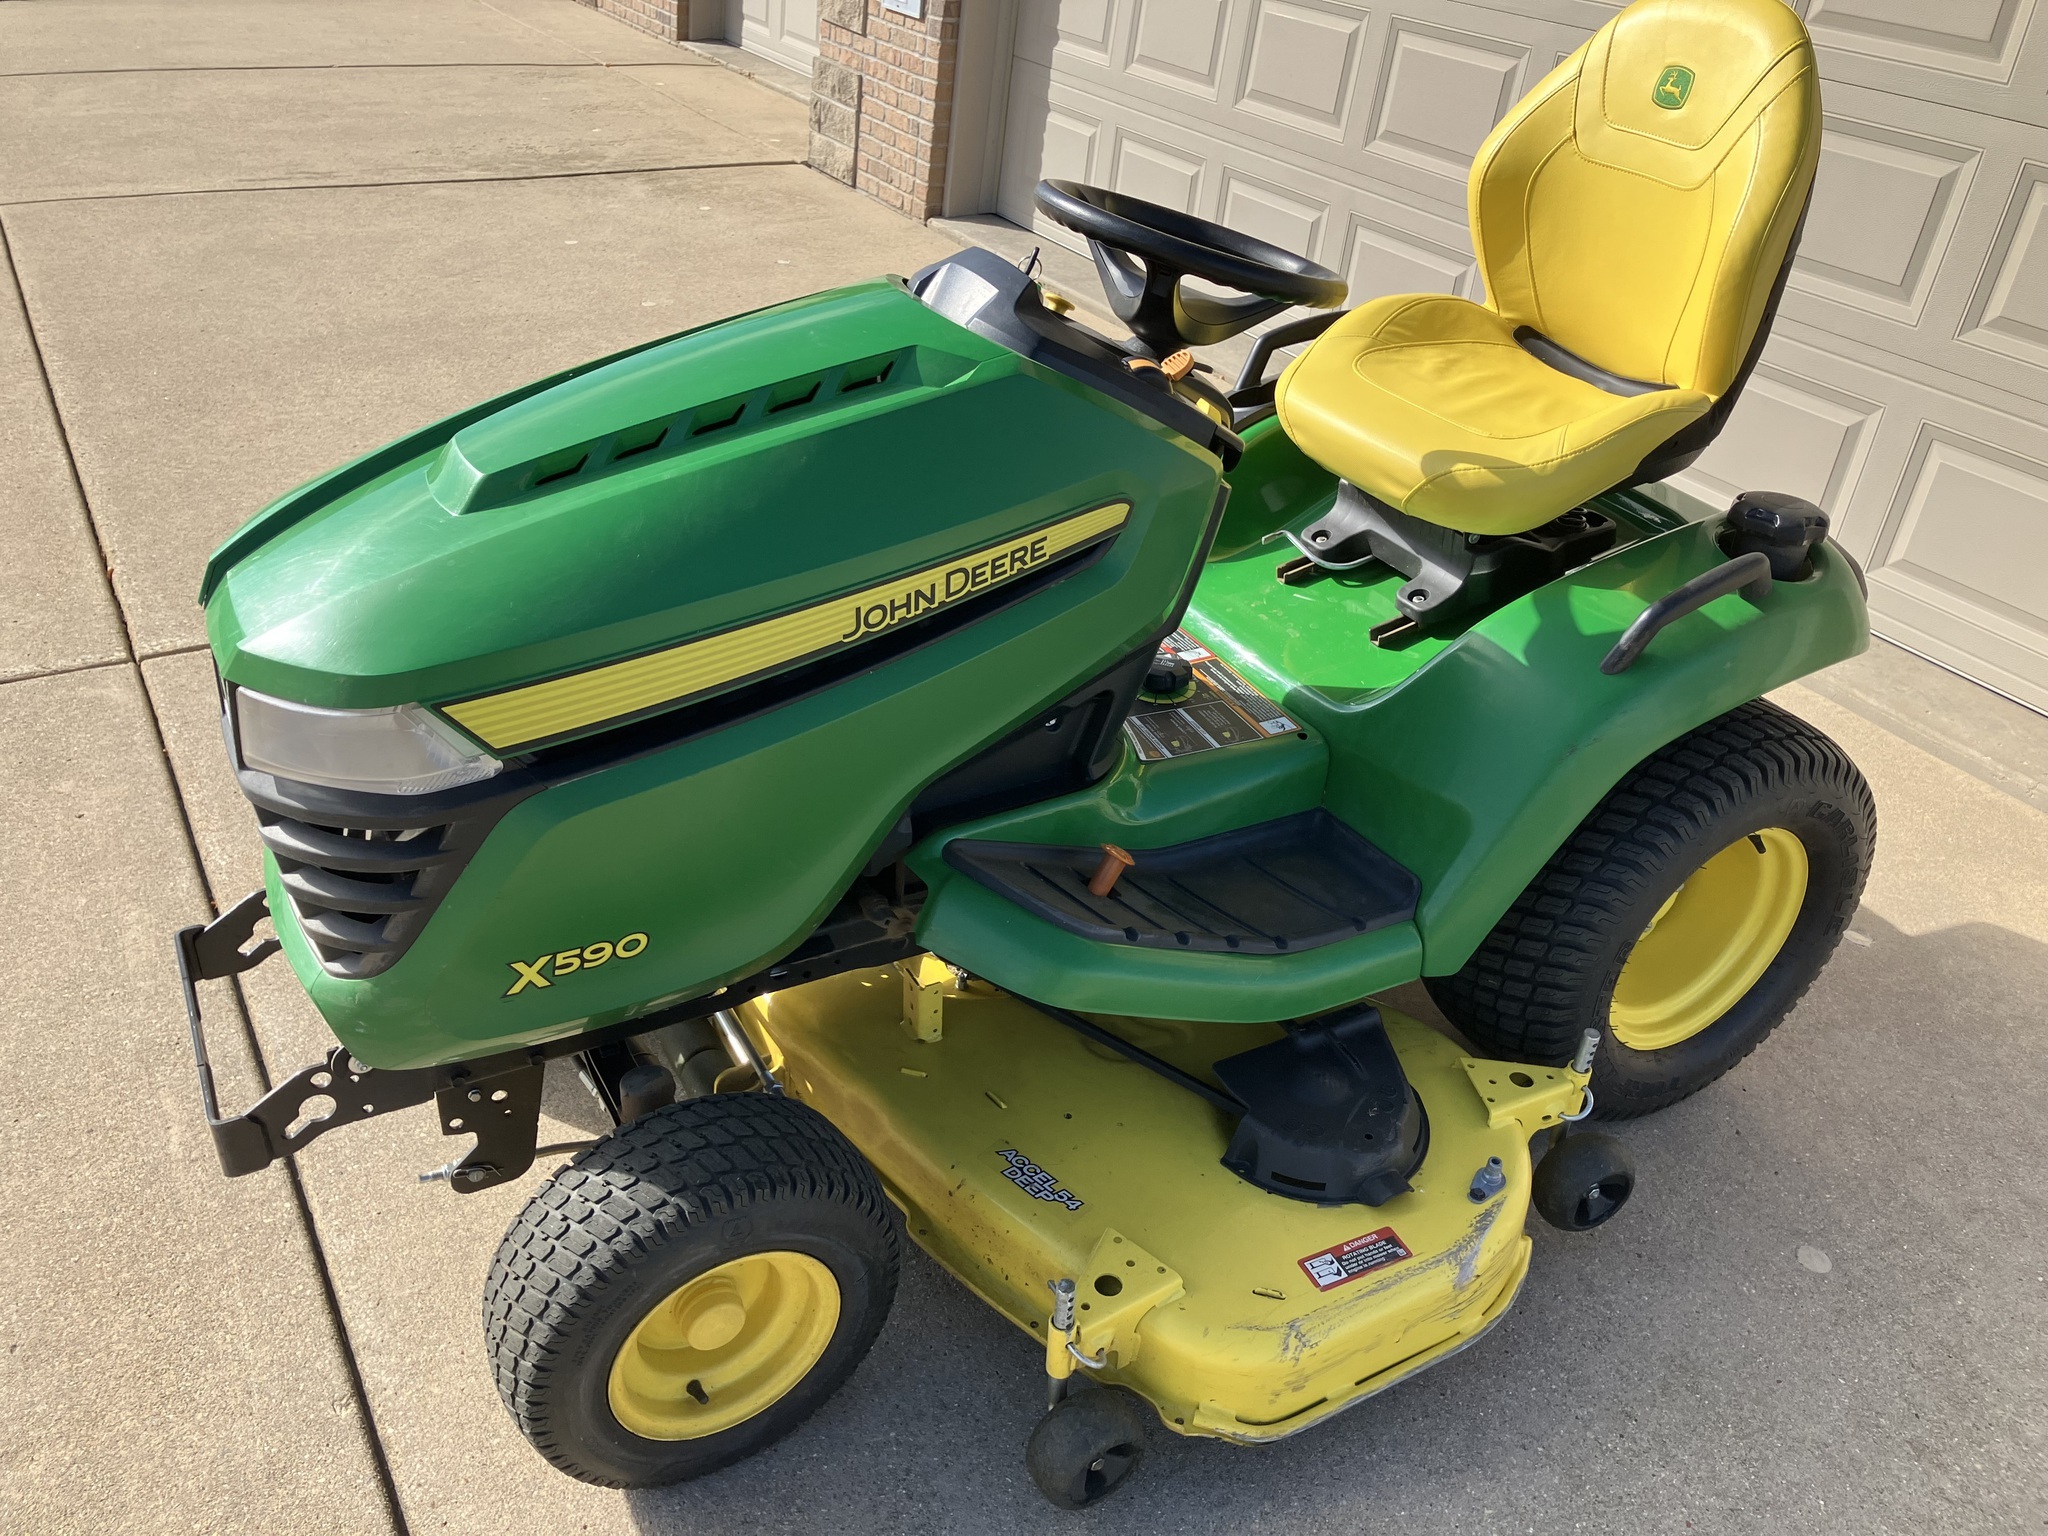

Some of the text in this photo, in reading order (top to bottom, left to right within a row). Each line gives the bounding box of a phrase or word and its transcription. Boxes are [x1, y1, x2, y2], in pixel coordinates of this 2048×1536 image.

[842, 536, 1049, 640] JOHN DEERE
[1806, 799, 1859, 936] CARLISLE
[502, 932, 650, 998] X590
[996, 1149, 1084, 1211] ACCEL 54
[1001, 1166, 1055, 1201] DEEP
[1341, 1240, 1387, 1260] ROTATING BLADE
[1349, 1233, 1378, 1248] DANGER
